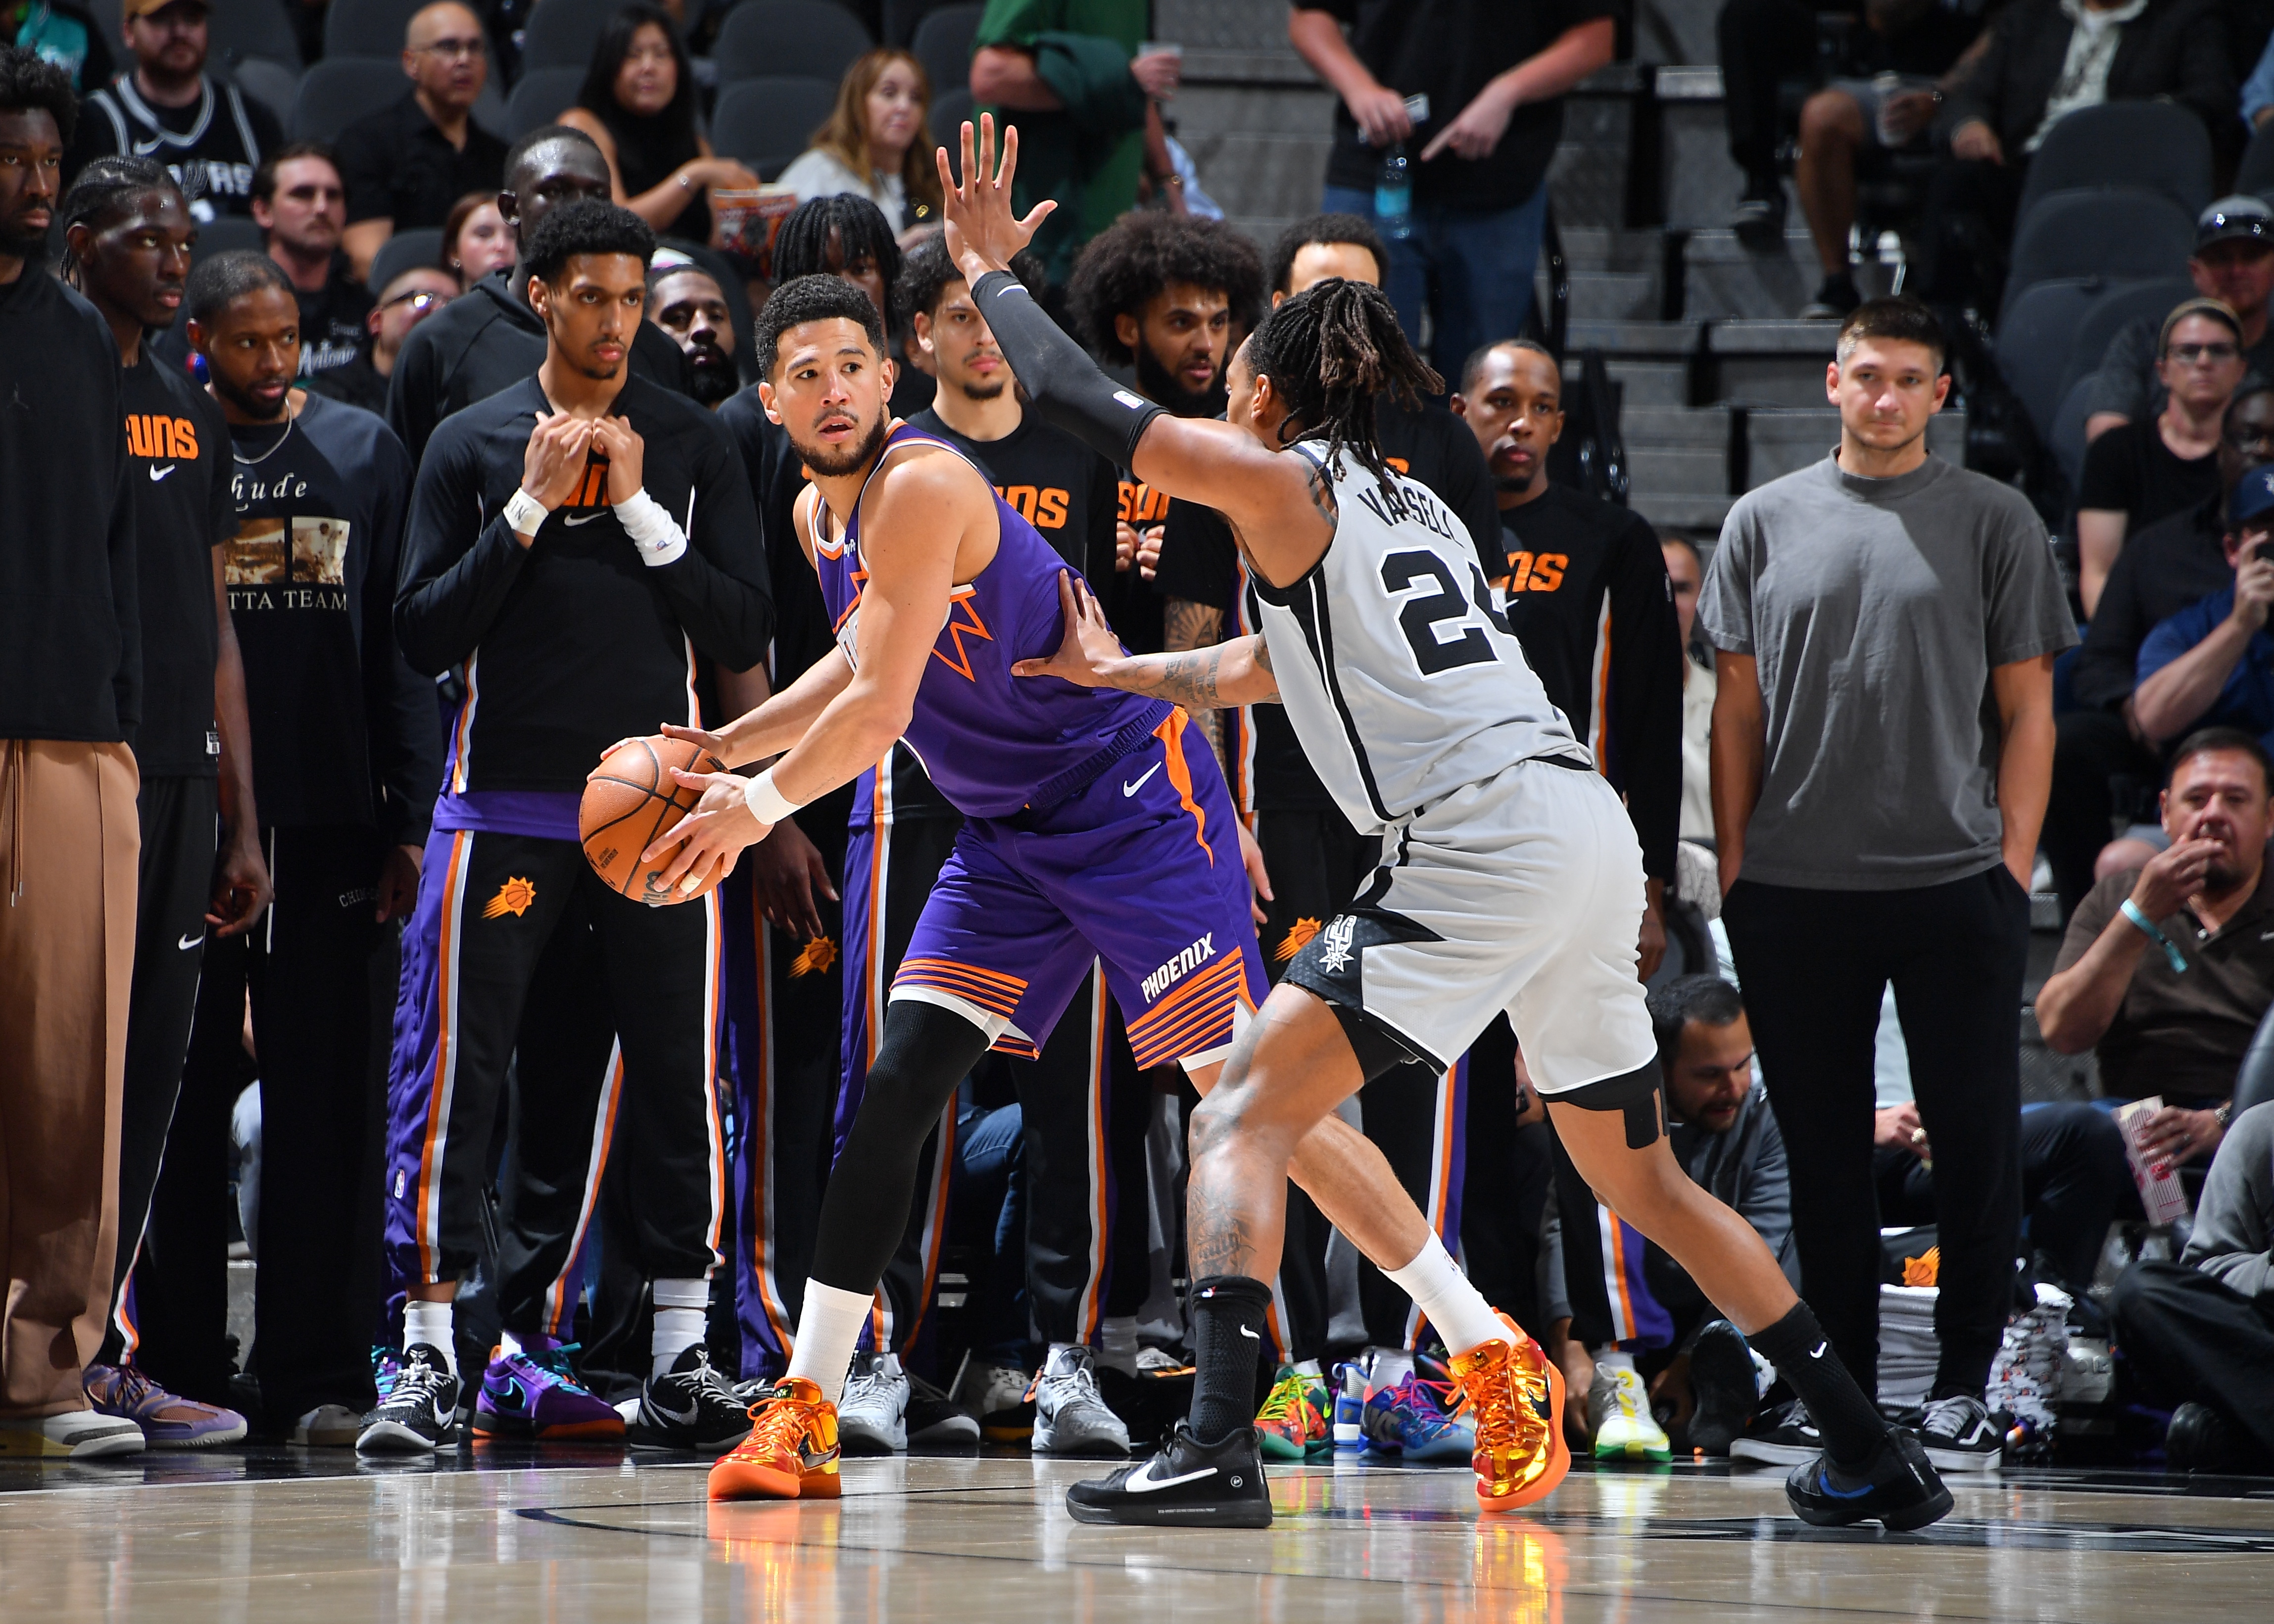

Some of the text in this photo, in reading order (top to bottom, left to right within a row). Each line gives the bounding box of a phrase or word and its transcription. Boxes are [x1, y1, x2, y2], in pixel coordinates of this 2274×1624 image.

[126, 414, 199, 460] UNS
[231, 472, 307, 501] hude
[994, 485, 1069, 529] NS
[228, 589, 347, 611] TTA TEAM
[1141, 932, 1216, 1003] PHOENIX
